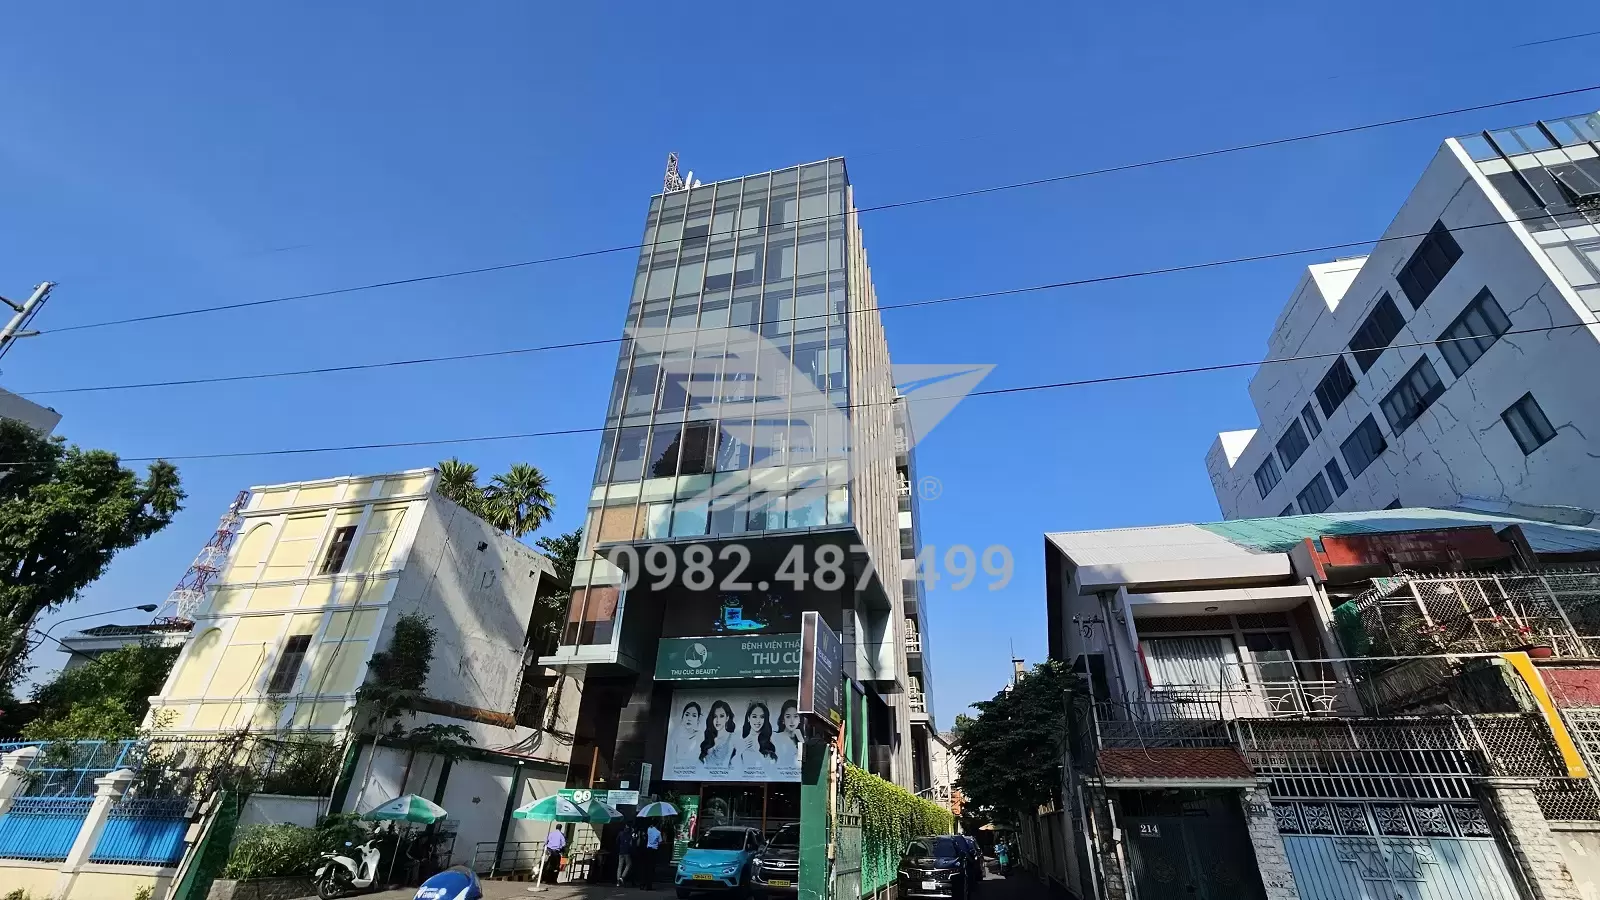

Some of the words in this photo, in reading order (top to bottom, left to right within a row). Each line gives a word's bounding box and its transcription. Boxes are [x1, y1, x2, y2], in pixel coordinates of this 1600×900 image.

[741, 641, 763, 651] BỆNH
[764, 640, 782, 650] VIỆN
[752, 652, 780, 665] THU
[1250, 804, 1265, 812] 214
[1140, 824, 1159, 833] 214
